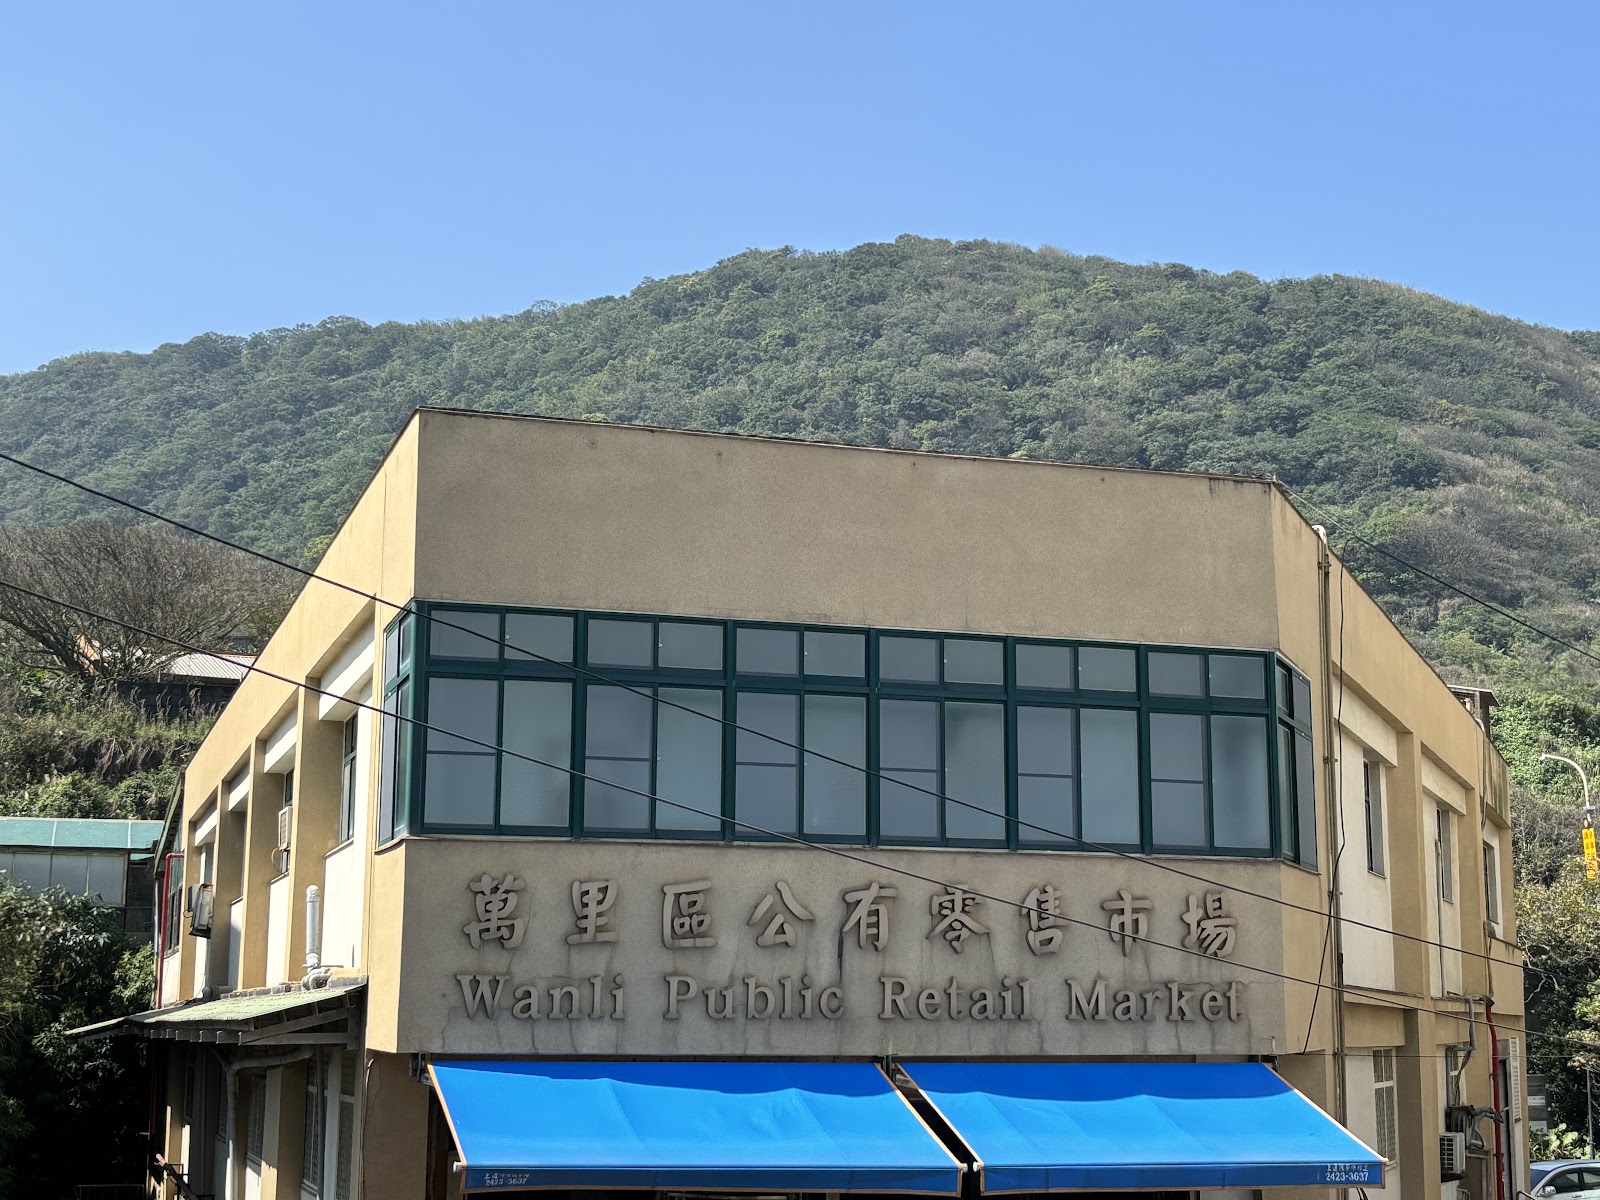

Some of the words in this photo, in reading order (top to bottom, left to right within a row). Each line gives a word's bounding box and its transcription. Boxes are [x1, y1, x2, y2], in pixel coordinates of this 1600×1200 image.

[463, 873, 1238, 957] 萬里區公有零售市場
[455, 973, 626, 1020] Wanli
[663, 974, 845, 1020] Public
[879, 975, 1032, 1021] Retail
[1065, 976, 1242, 1023] Market
